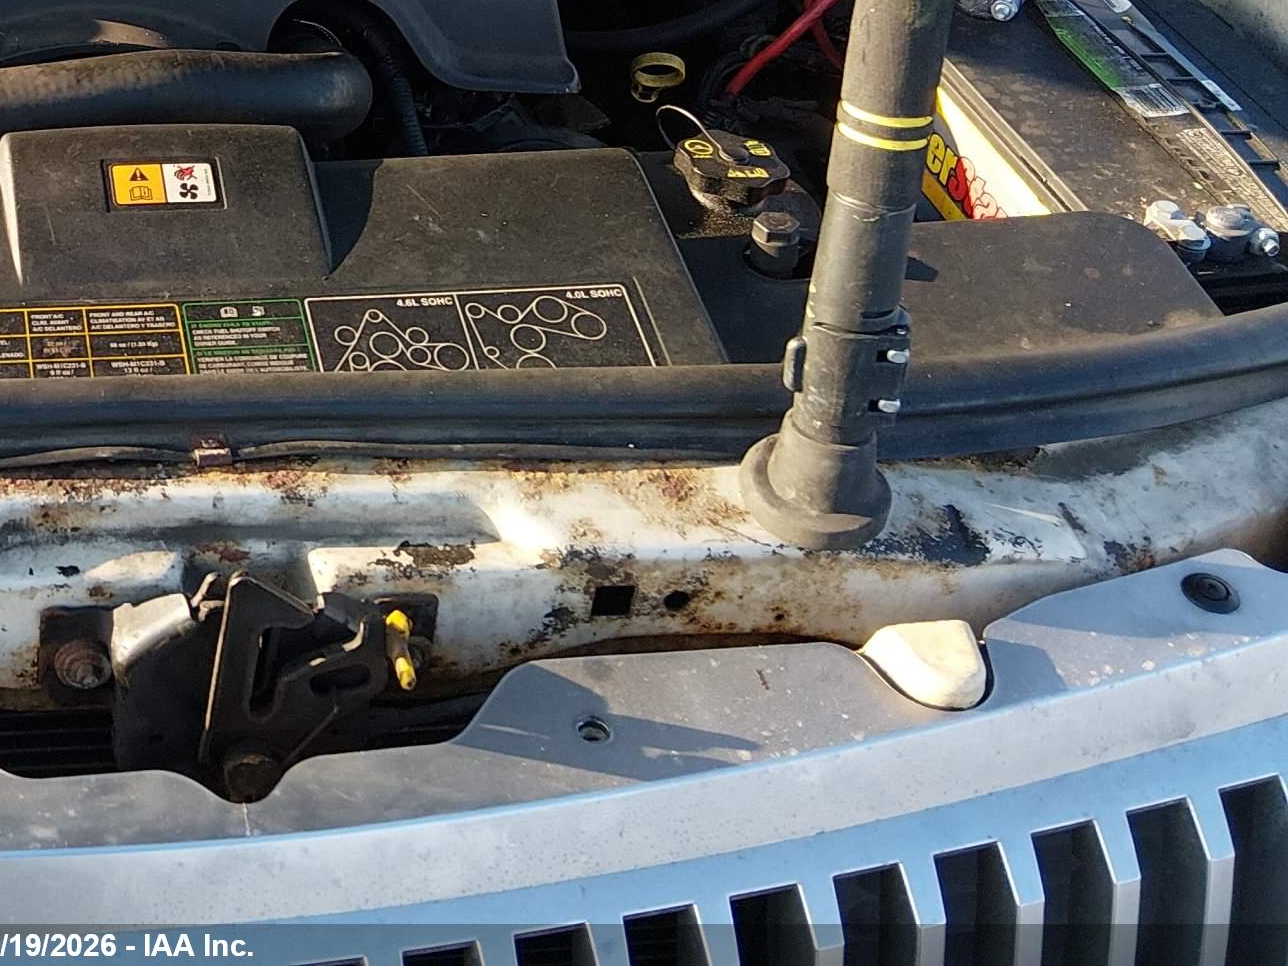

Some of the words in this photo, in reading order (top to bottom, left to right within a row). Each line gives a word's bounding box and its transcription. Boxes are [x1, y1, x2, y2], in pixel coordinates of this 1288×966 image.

[565, 289, 589, 300] 4.0L
[590, 288, 623, 298] SOHC
[396, 297, 420, 307] 4.6L
[420, 296, 454, 306] SOHC
